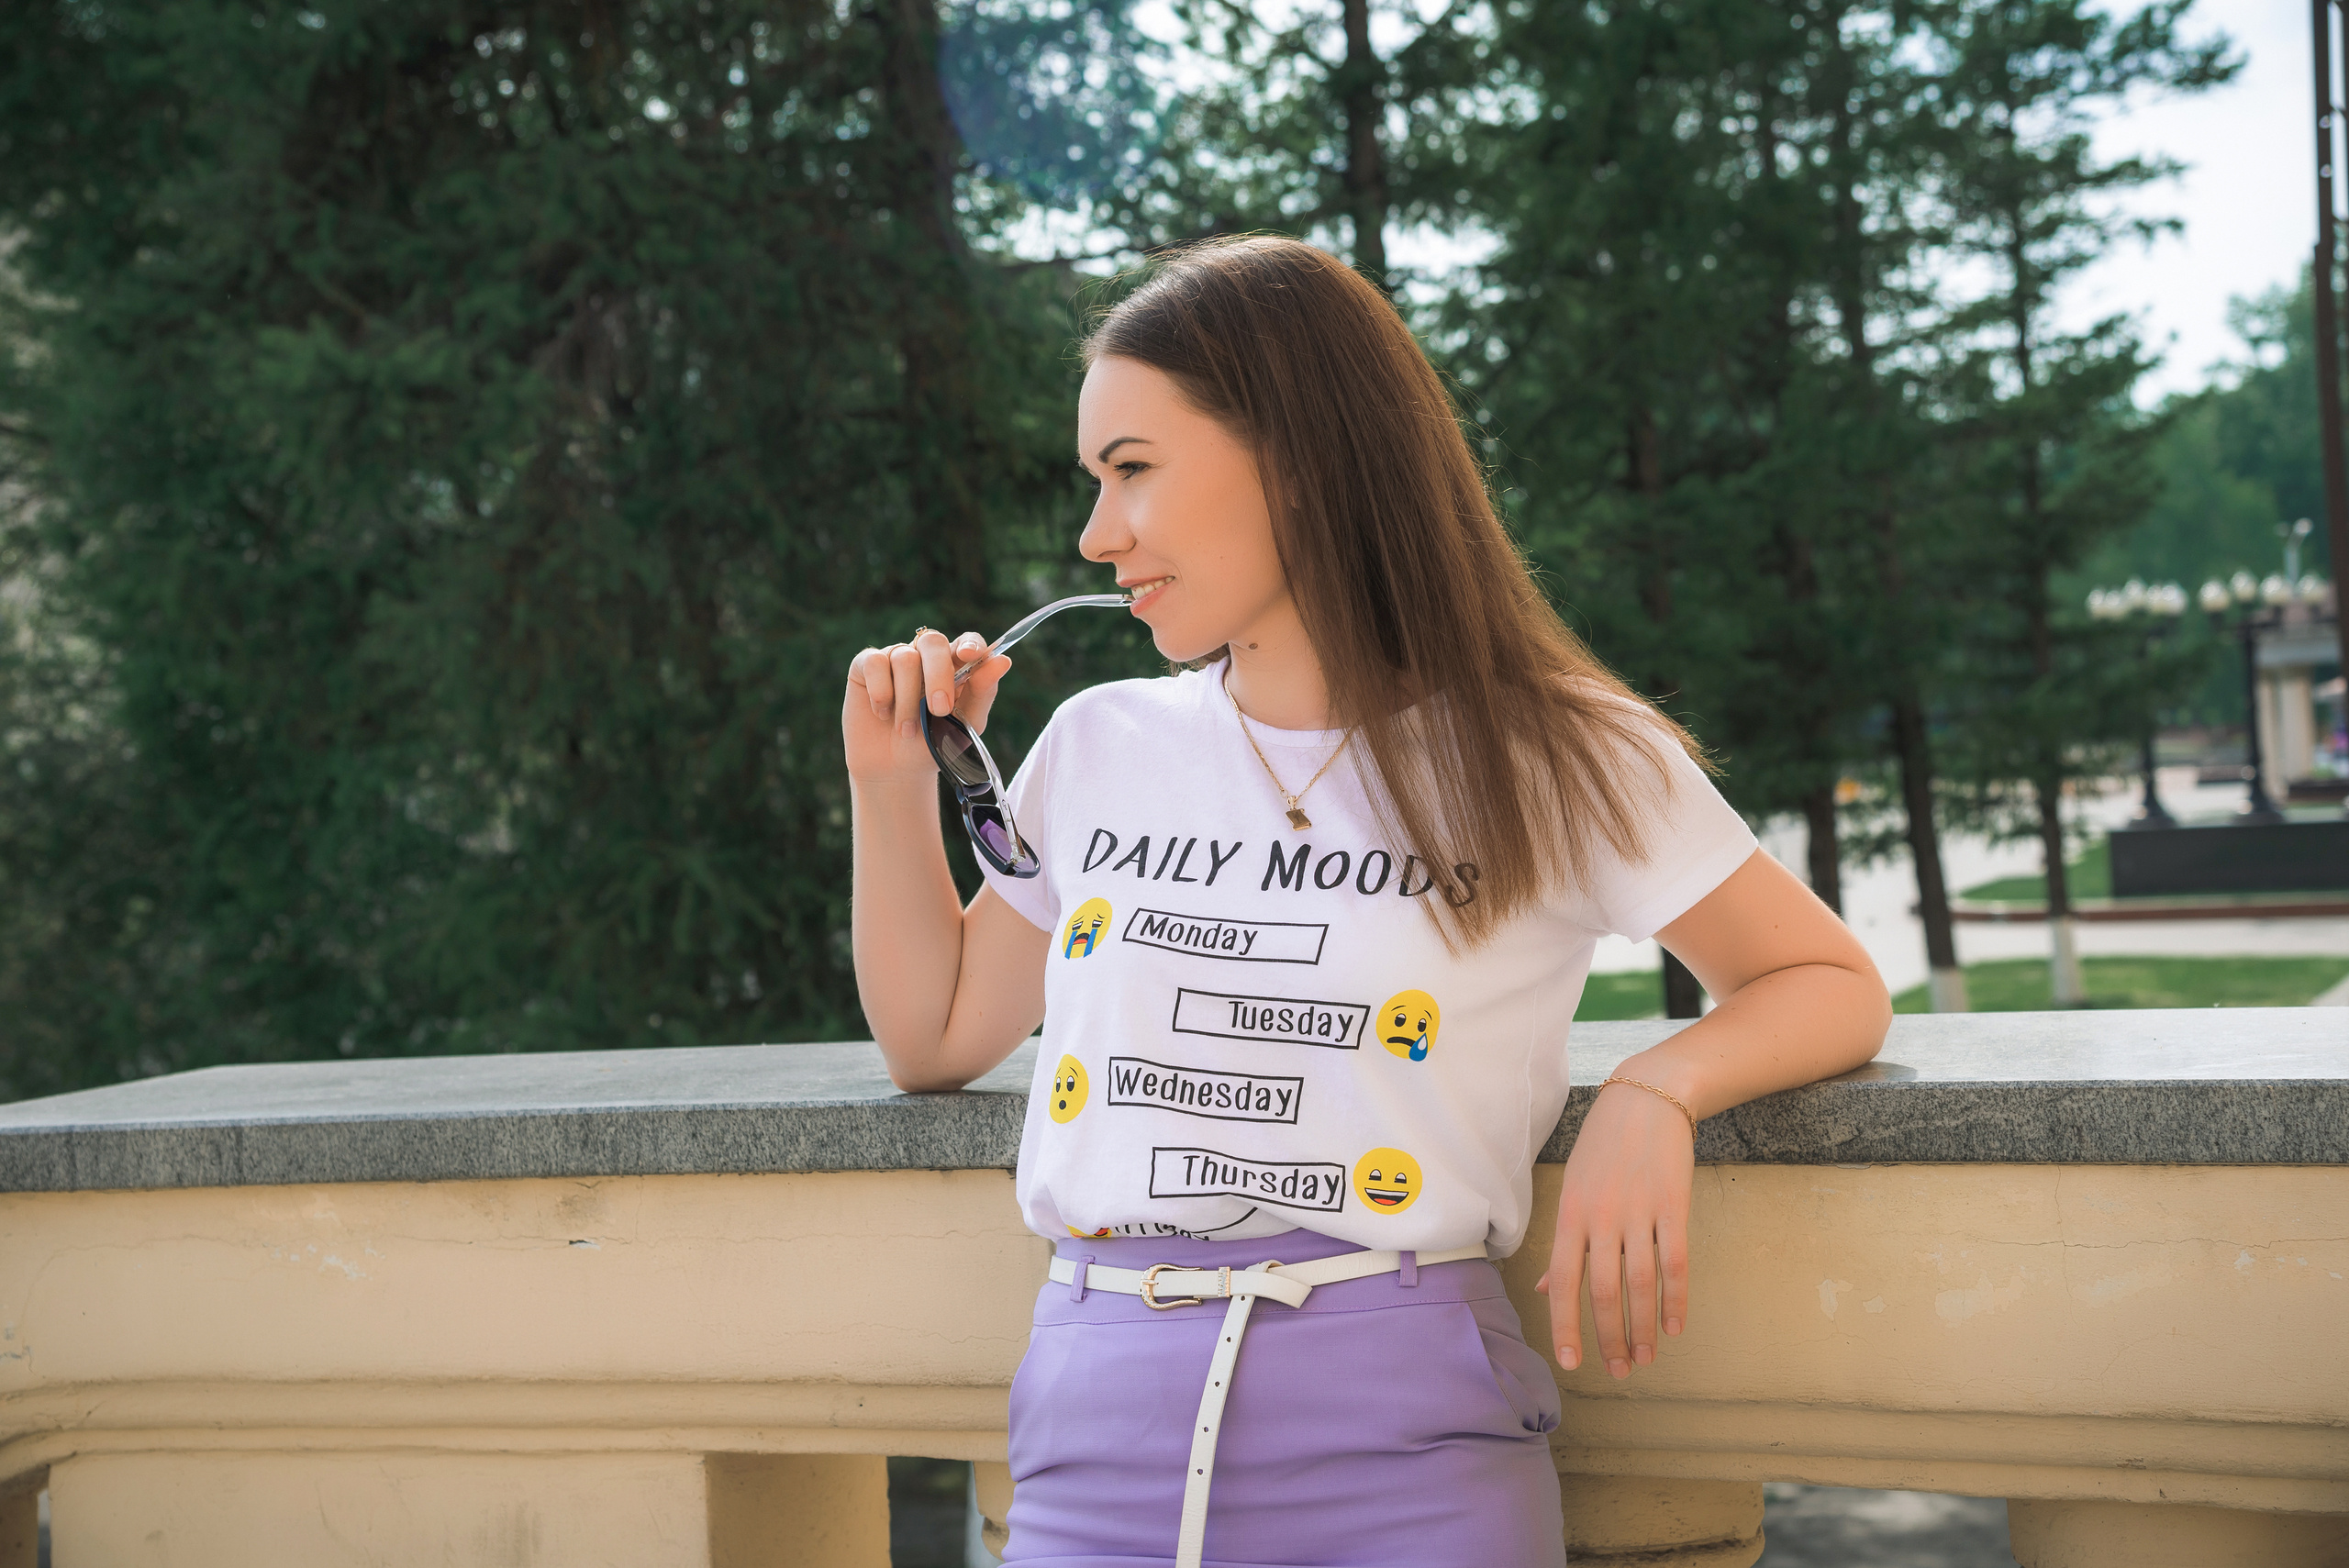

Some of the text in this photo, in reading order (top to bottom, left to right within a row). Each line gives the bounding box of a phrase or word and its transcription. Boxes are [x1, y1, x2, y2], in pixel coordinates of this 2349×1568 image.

[1083, 828, 1480, 908] DAILY MOODS
[1141, 914, 1258, 955] Monday
[1228, 1001, 1354, 1043] Tuesday
[1116, 1065, 1293, 1117] Wednesday
[1183, 1155, 1341, 1206] Thursday
